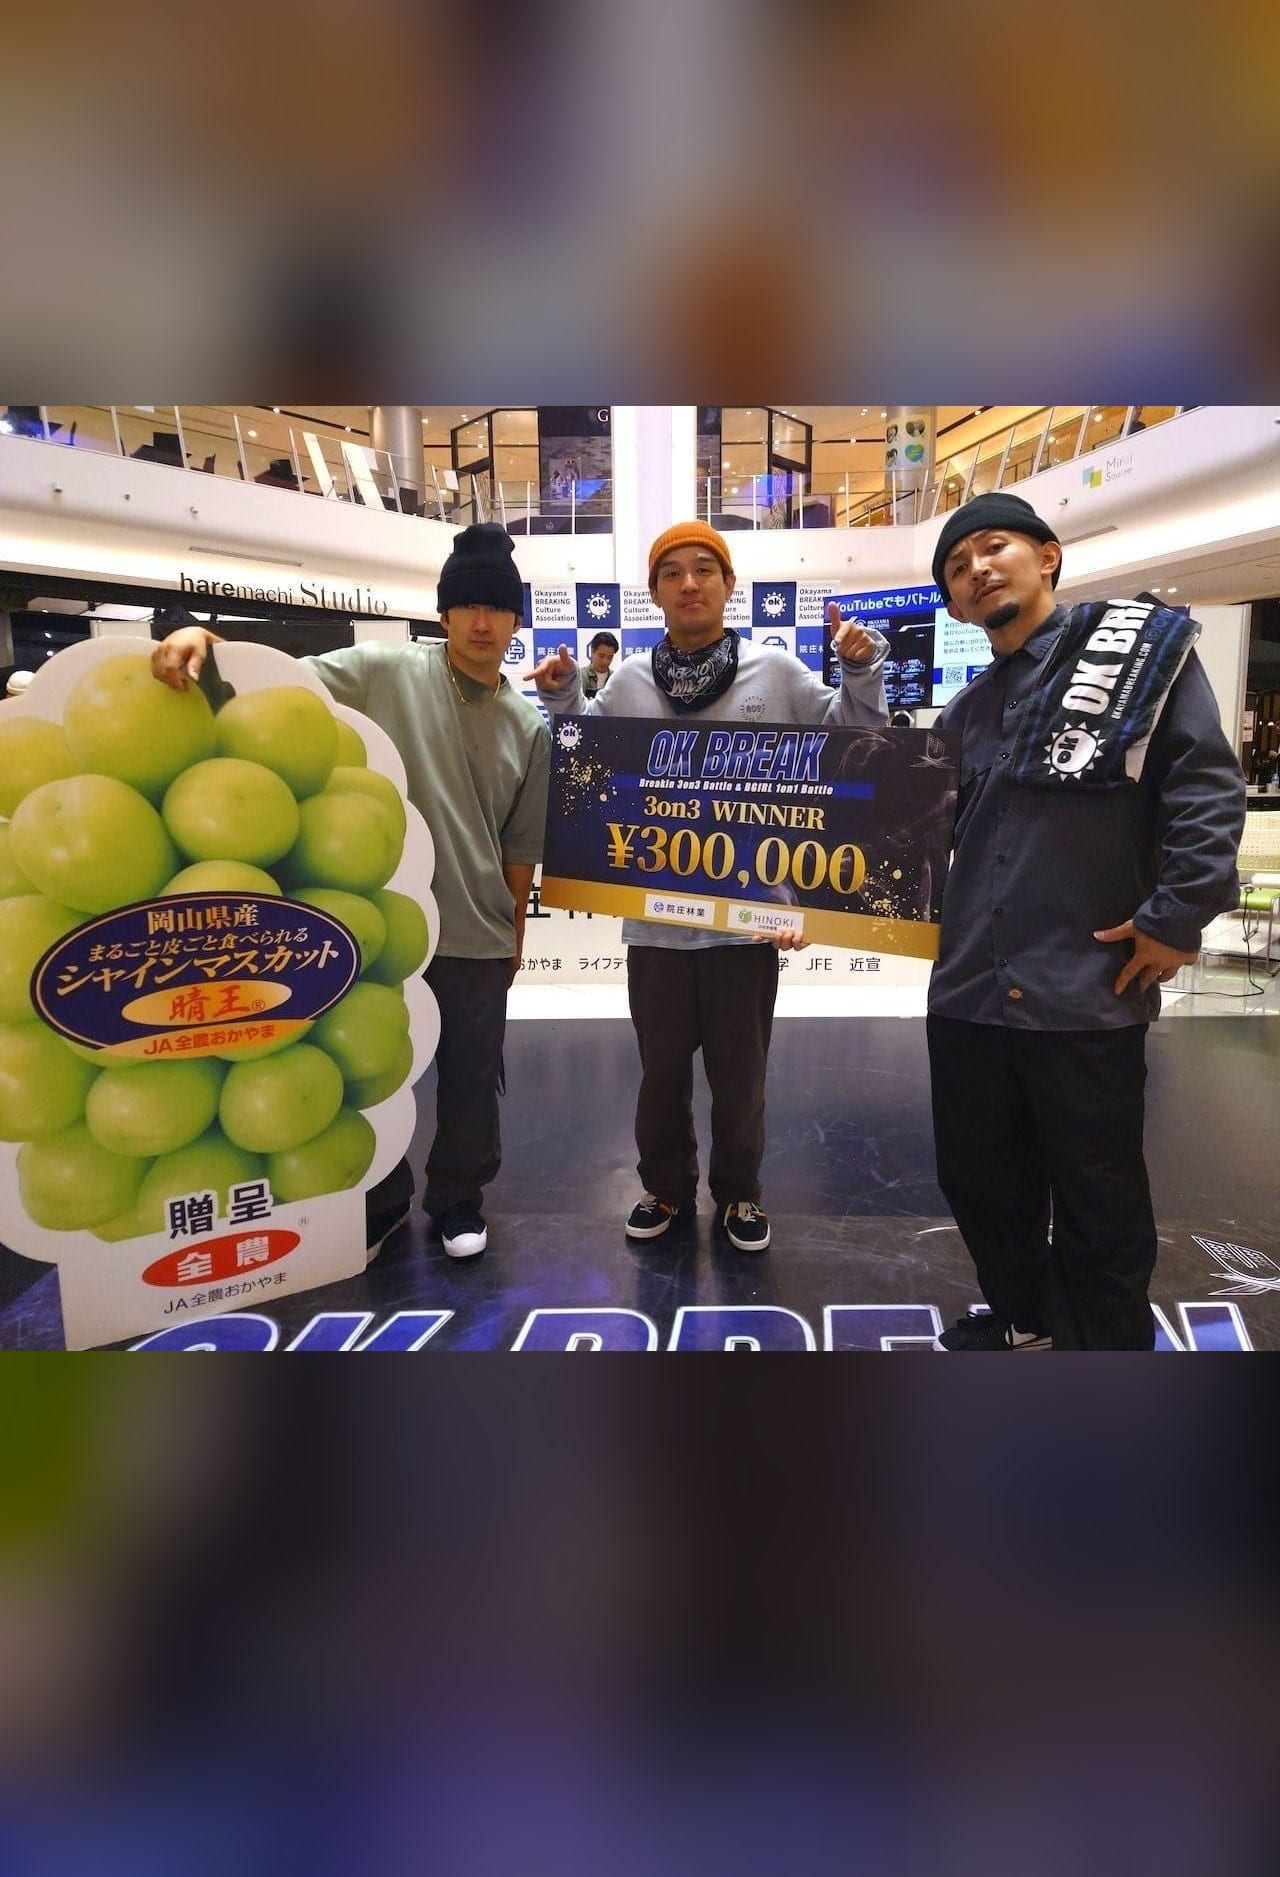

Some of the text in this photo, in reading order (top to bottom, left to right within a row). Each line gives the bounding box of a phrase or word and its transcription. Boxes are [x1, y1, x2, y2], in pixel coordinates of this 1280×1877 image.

[180, 572, 388, 616] haremachi Studio
[534, 590, 567, 598] Okayama
[799, 588, 832, 596] Okayama
[837, 591, 944, 613] ouTubeでもバトル
[624, 614, 663, 622] Association
[1062, 658, 1124, 715] OK
[646, 729, 830, 782] OK BREAK
[638, 778, 675, 789] Breakin
[676, 779, 701, 790] 3on3
[702, 781, 733, 792] Battle
[775, 784, 799, 794] 1on1
[800, 784, 834, 796] Battle
[643, 795, 826, 831] 3on3 WINNER
[606, 821, 866, 896] ¥300,000
[146, 902, 260, 935] 岡山県産
[666, 903, 705, 918] 院庄林業
[753, 914, 794, 928] HINOKI
[87, 926, 309, 964] まるごと皮ごと食べられる
[56, 940, 341, 997] シャインマスカット
[578, 957, 629, 971] ライフデ
[806, 957, 833, 971] JFE
[849, 957, 881, 972] 近宣
[143, 1024, 276, 1056] JA全農おかやま
[169, 1183, 272, 1240] 贈呈
[176, 1235, 270, 1282] 全農
[163, 1271, 289, 1314] JA全農おかやま
